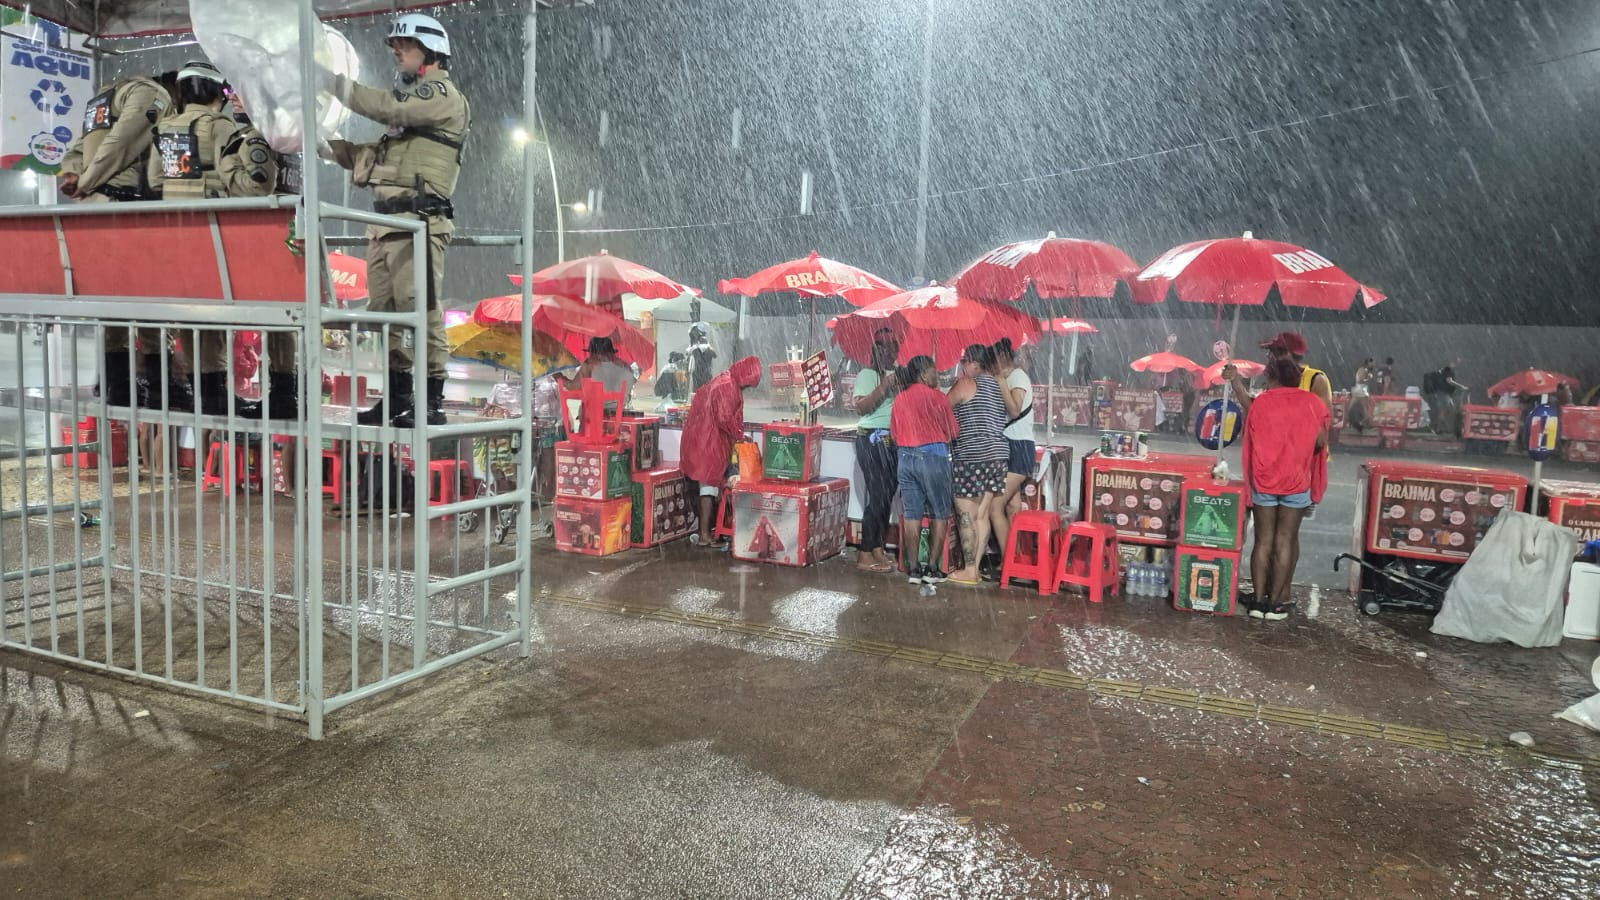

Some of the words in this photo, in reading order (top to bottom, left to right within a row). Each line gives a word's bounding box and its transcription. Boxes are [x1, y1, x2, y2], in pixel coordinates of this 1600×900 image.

[11, 51, 90, 80] AQUI
[181, 154, 191, 173] C
[331, 269, 357, 287] MA
[771, 436, 800, 445] BEATS
[1095, 473, 1138, 490] BRAHMA
[1193, 495, 1231, 506] BEATS
[1384, 483, 1436, 502] BRAHMA
